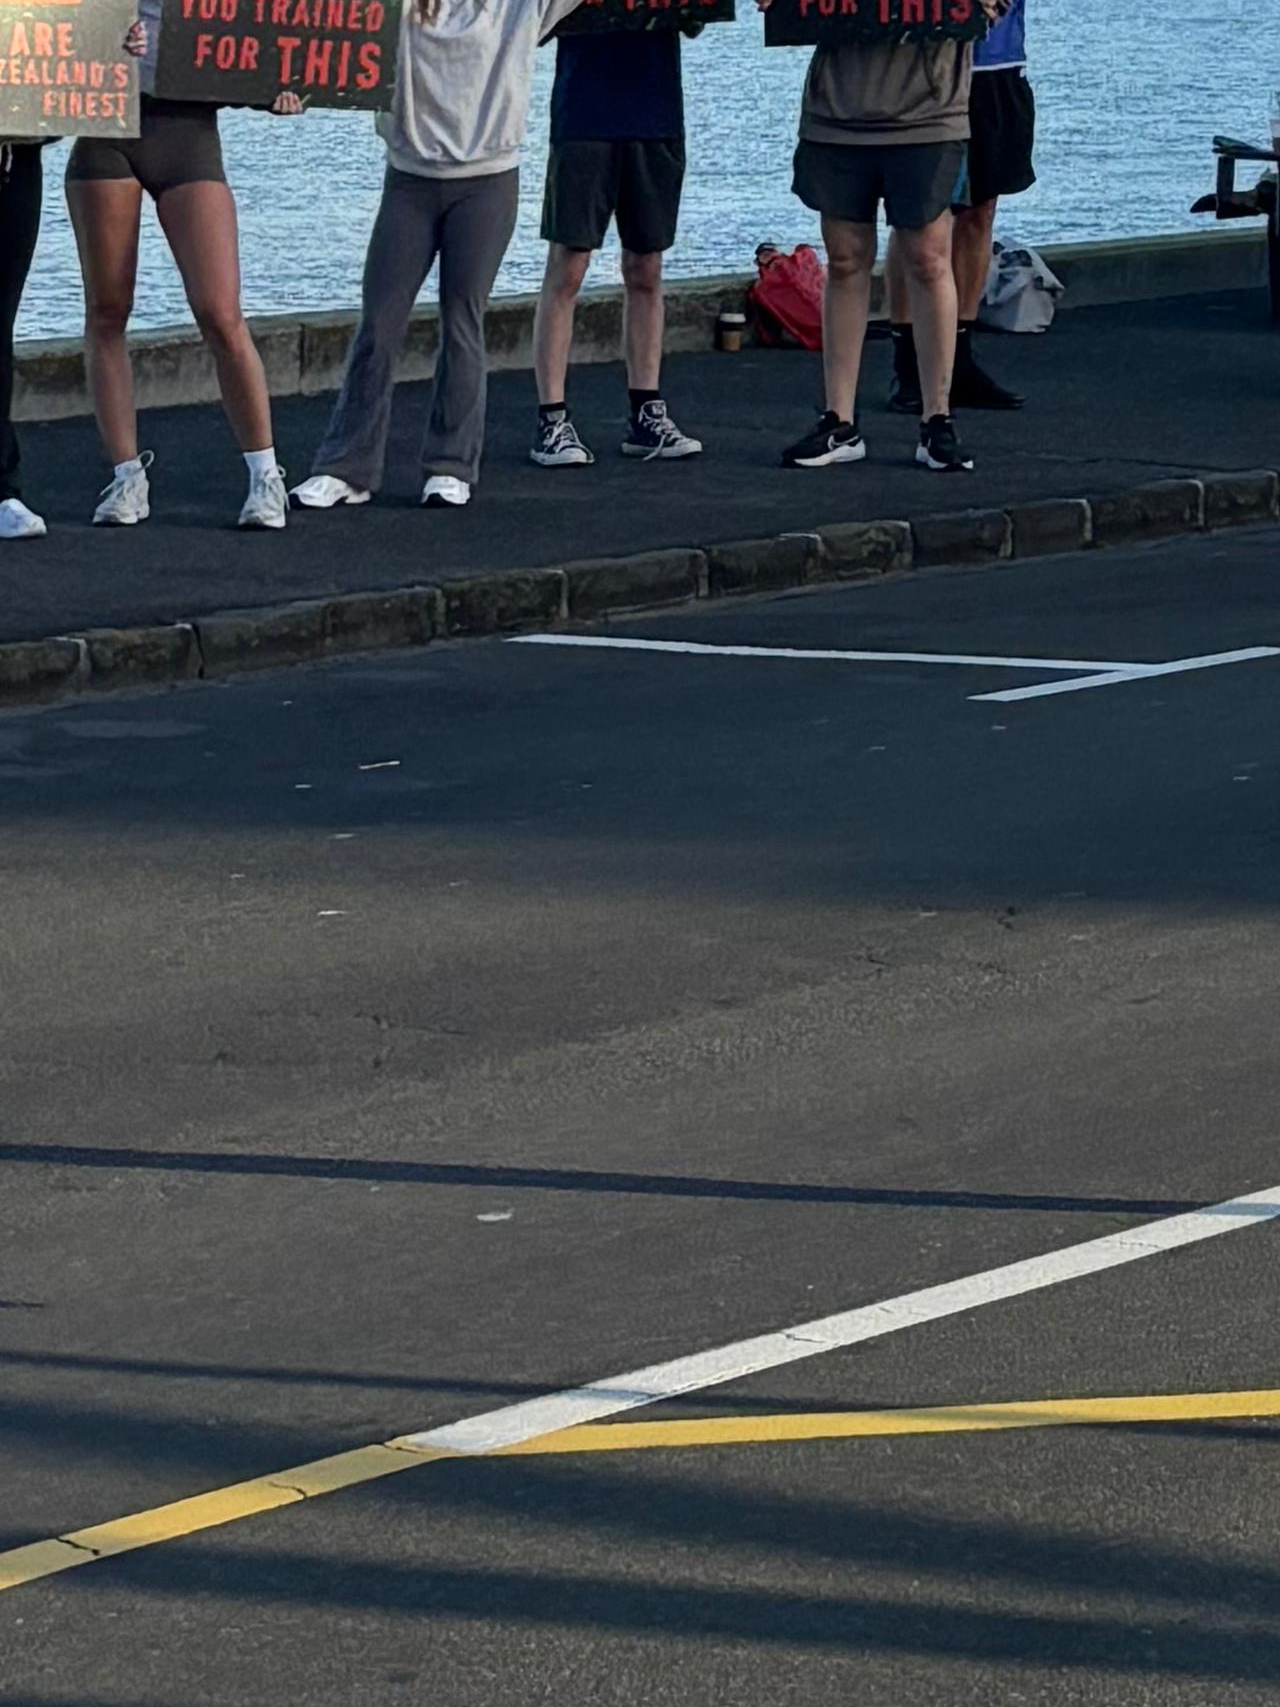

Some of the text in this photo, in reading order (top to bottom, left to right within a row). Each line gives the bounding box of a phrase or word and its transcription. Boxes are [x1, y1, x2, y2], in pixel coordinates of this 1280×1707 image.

[9, 21, 76, 57] ARE
[194, 35, 381, 90] FOR THIS
[42, 90, 128, 117] FINEST
